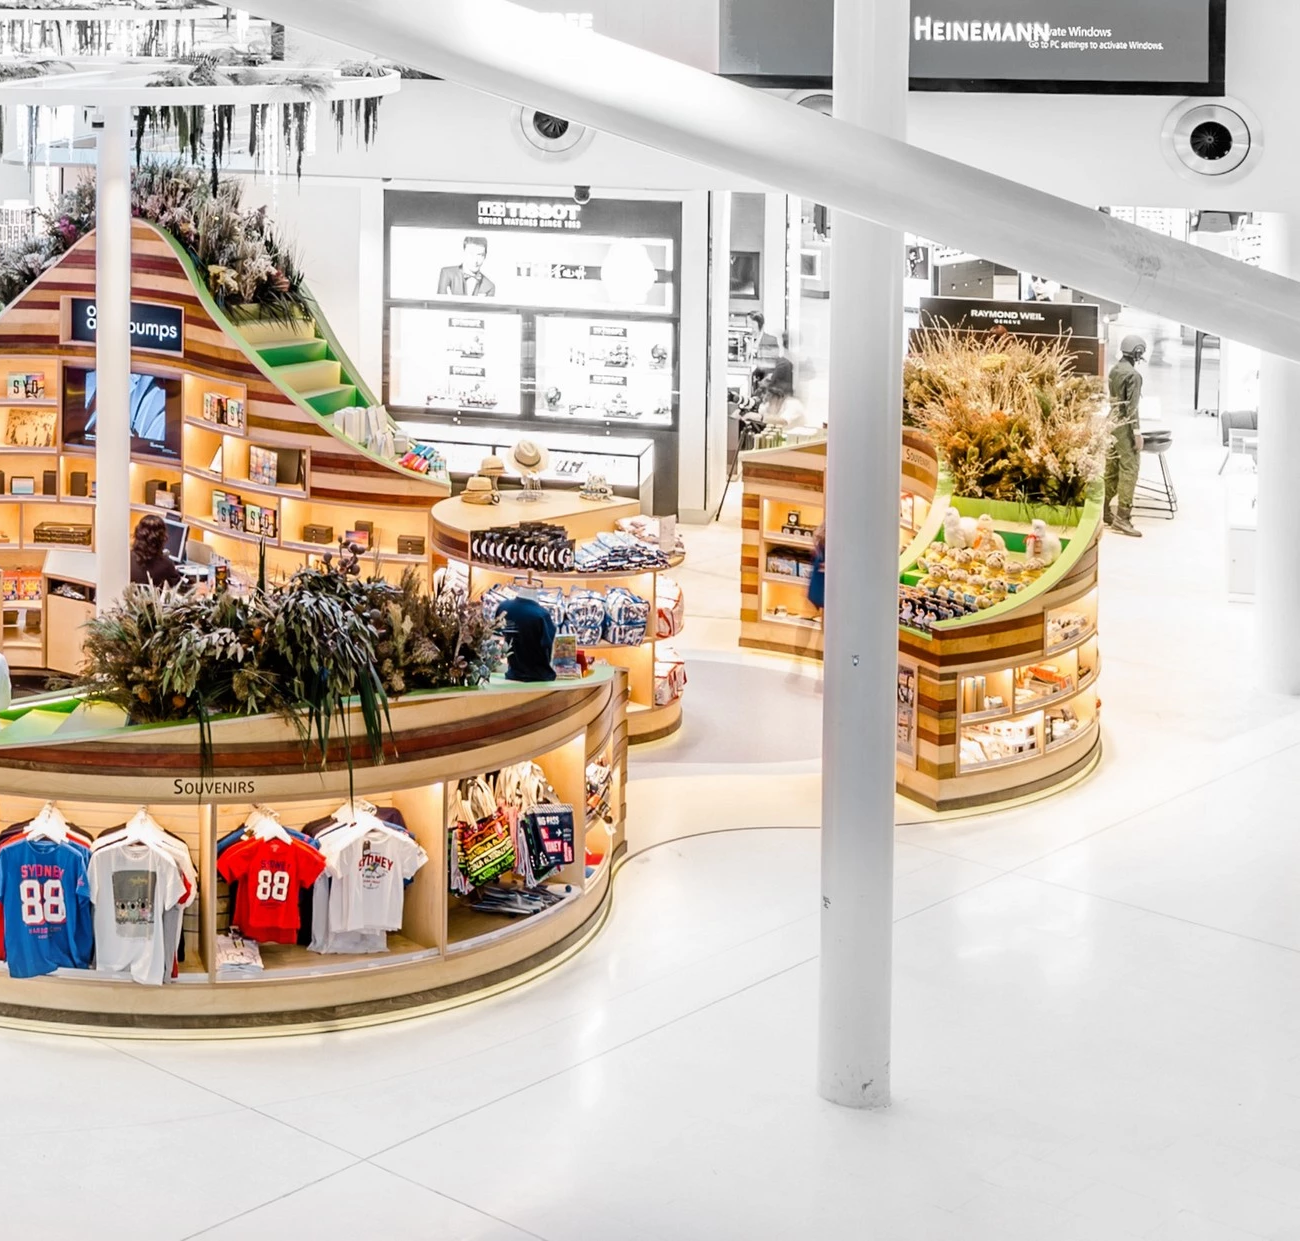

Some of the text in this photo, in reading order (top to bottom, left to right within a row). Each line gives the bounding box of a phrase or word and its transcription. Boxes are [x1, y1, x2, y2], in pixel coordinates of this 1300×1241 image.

[913, 15, 1050, 42] HEINEMANN
[1068, 26, 1112, 38] Windows
[1028, 40, 1164, 51] Go to PC settings to activate Windows.
[506, 203, 581, 220] TISSOT
[970, 309, 1045, 321] RAYMOND WEIL
[173, 778, 255, 795] SOUVENIRS
[20, 863, 65, 880] SYDNEY
[256, 869, 290, 902] 88
[19, 878, 67, 925] 88
